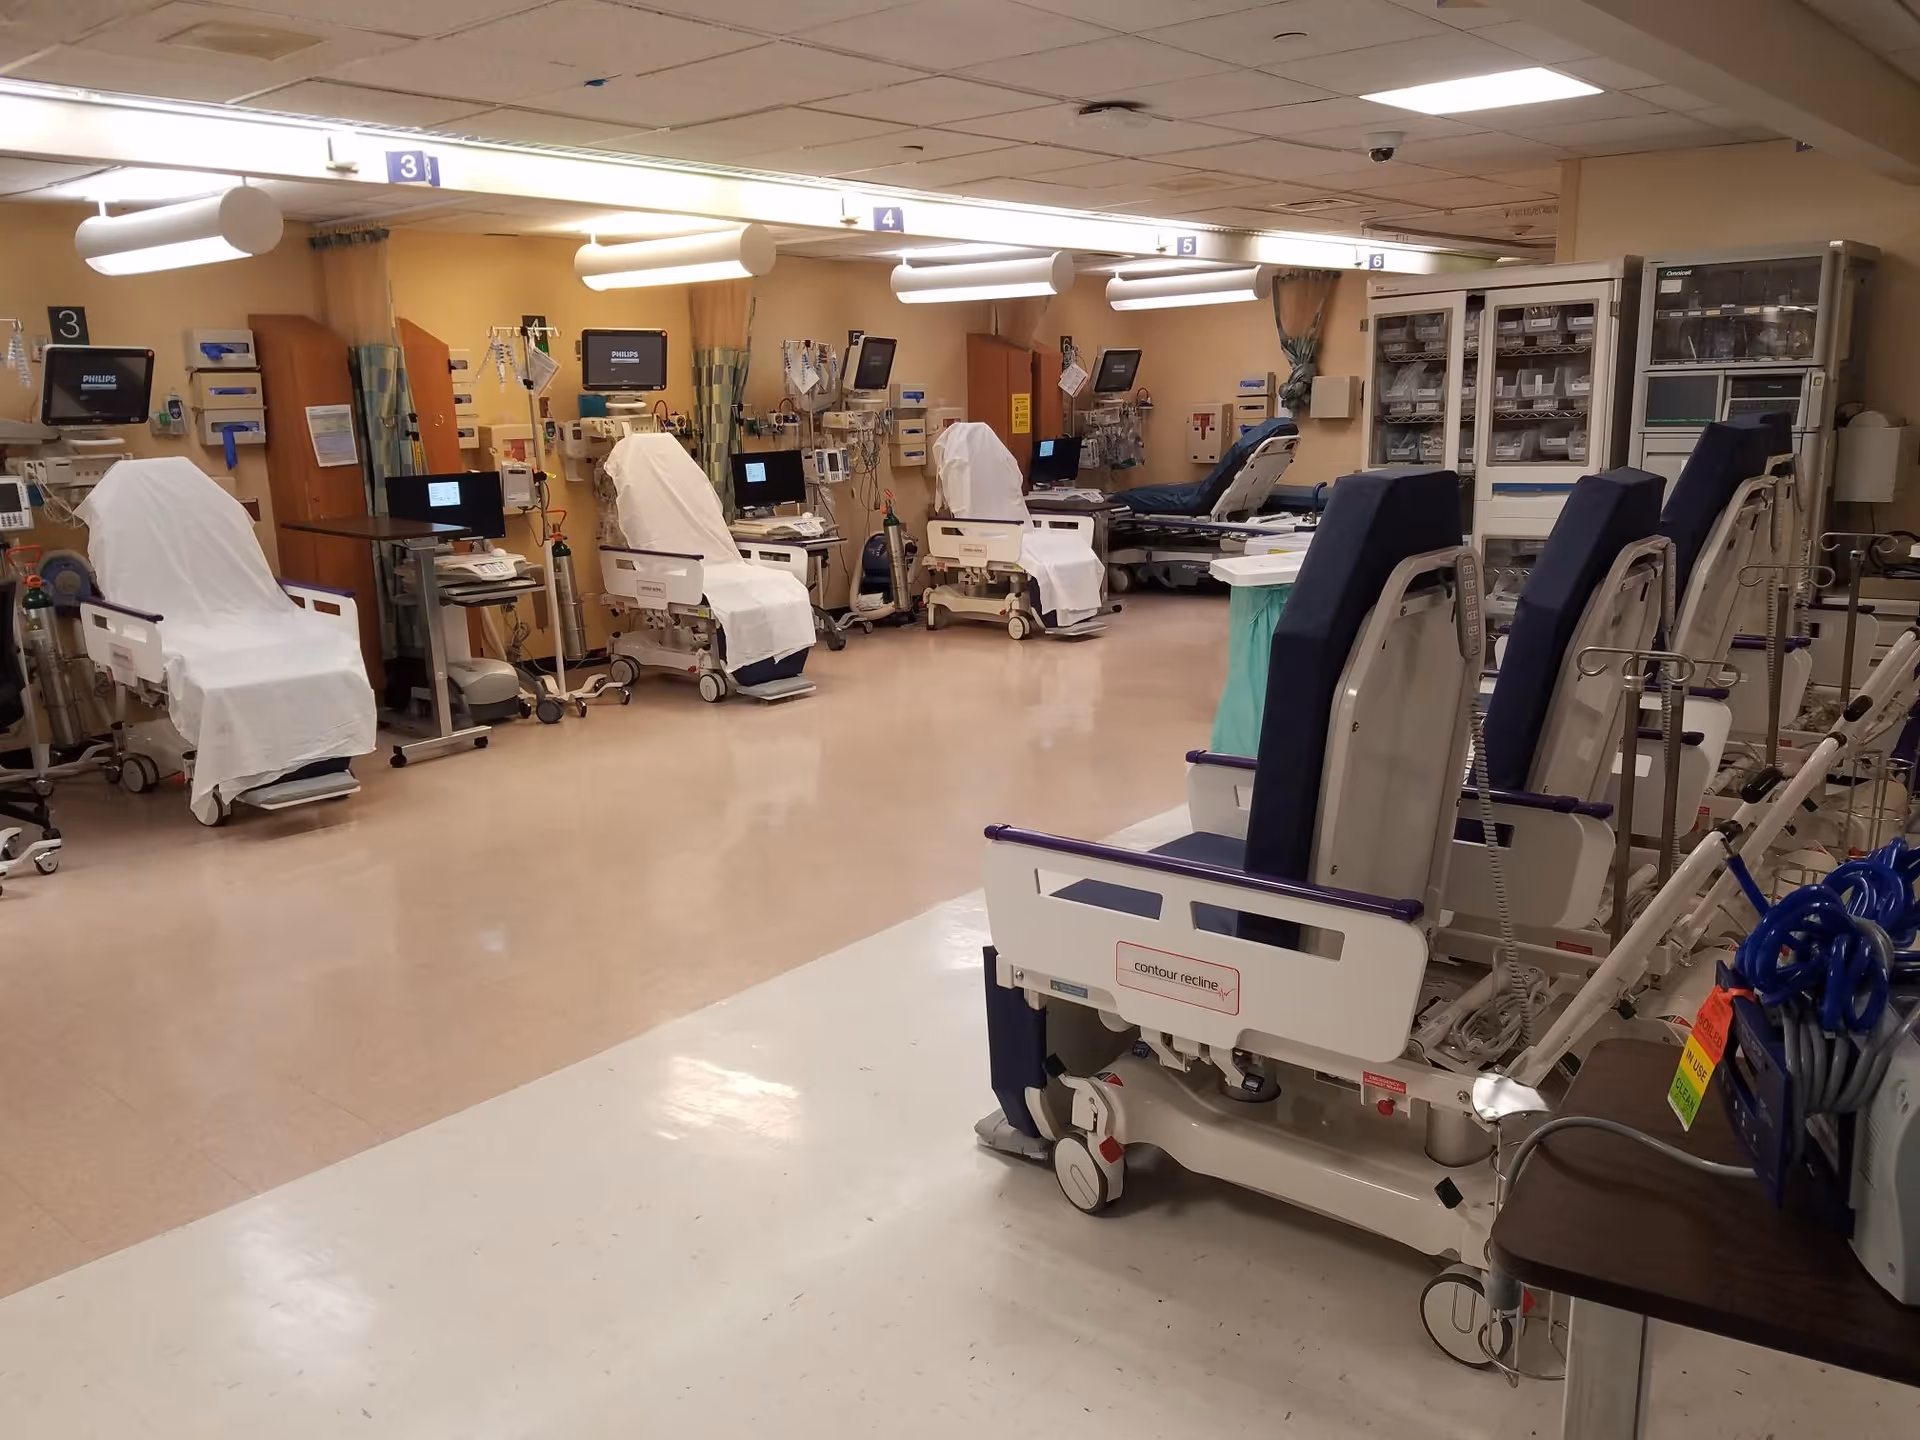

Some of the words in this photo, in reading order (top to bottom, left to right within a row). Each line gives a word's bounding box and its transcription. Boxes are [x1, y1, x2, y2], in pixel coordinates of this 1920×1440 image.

[400, 154, 417, 178] 3
[881, 208, 895, 228] 4
[1183, 238, 1193, 253] 5
[1373, 255, 1382, 268] 6
[59, 310, 80, 338] 3
[611, 350, 639, 358] PHILIPS
[82, 375, 117, 383] PHILIPS
[1134, 962, 1178, 981] contour
[1180, 973, 1219, 991] recline
[1698, 1013, 1723, 1049] SOILED
[1686, 1048, 1693, 1064] IN
[1693, 1061, 1707, 1083] USE
[1675, 1077, 1696, 1112] CLEAN
